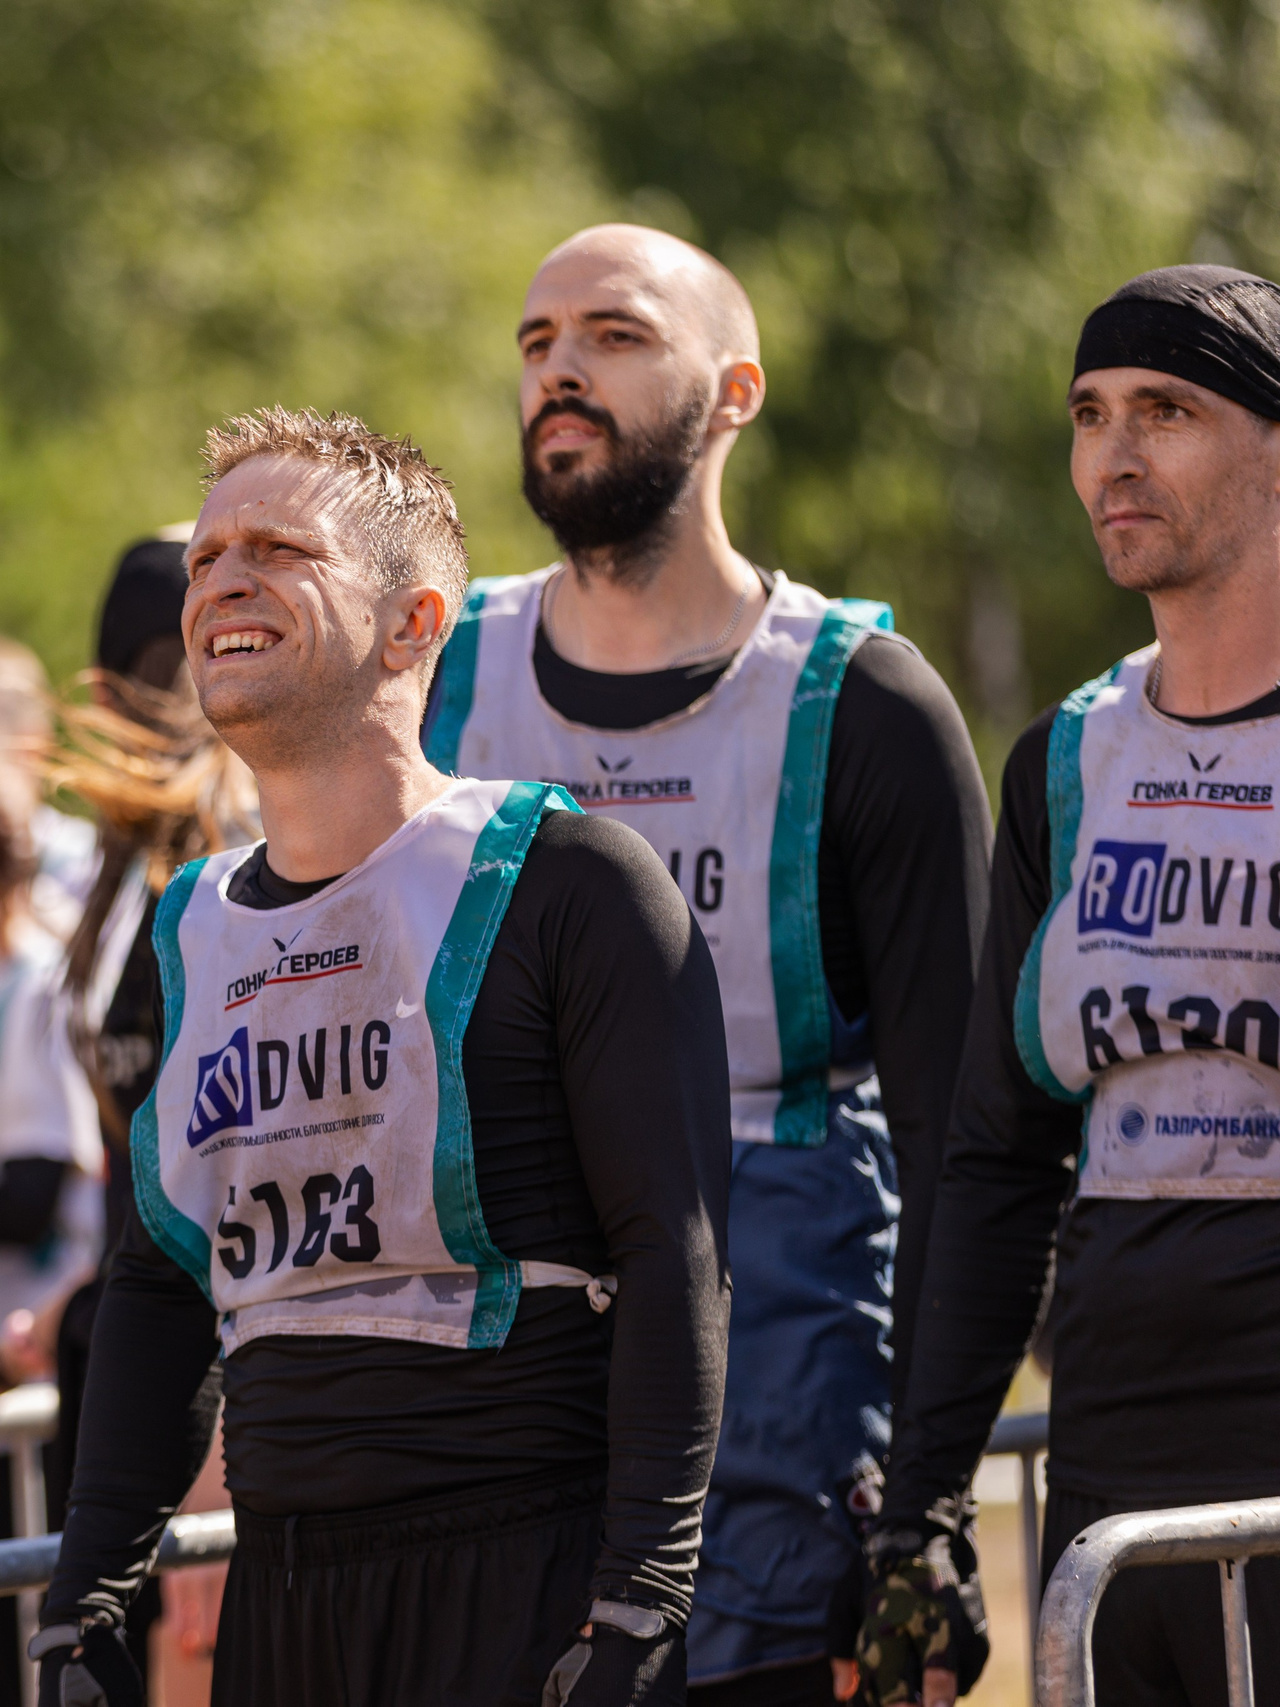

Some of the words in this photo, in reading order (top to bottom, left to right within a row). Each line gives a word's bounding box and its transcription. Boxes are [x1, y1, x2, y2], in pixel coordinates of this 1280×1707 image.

[540, 777, 605, 800] НКА
[608, 777, 693, 799] ГЕРОЕВ
[1132, 780, 1188, 800] ГОНКА
[1194, 781, 1273, 803] ГЕРОЕВ
[226, 966, 276, 1002] ГОНК
[276, 944, 360, 975] ГЕРОЕВ
[1154, 1114, 1280, 1138] ГАЗПРОМБАНК
[217, 1164, 382, 1280] 5163
